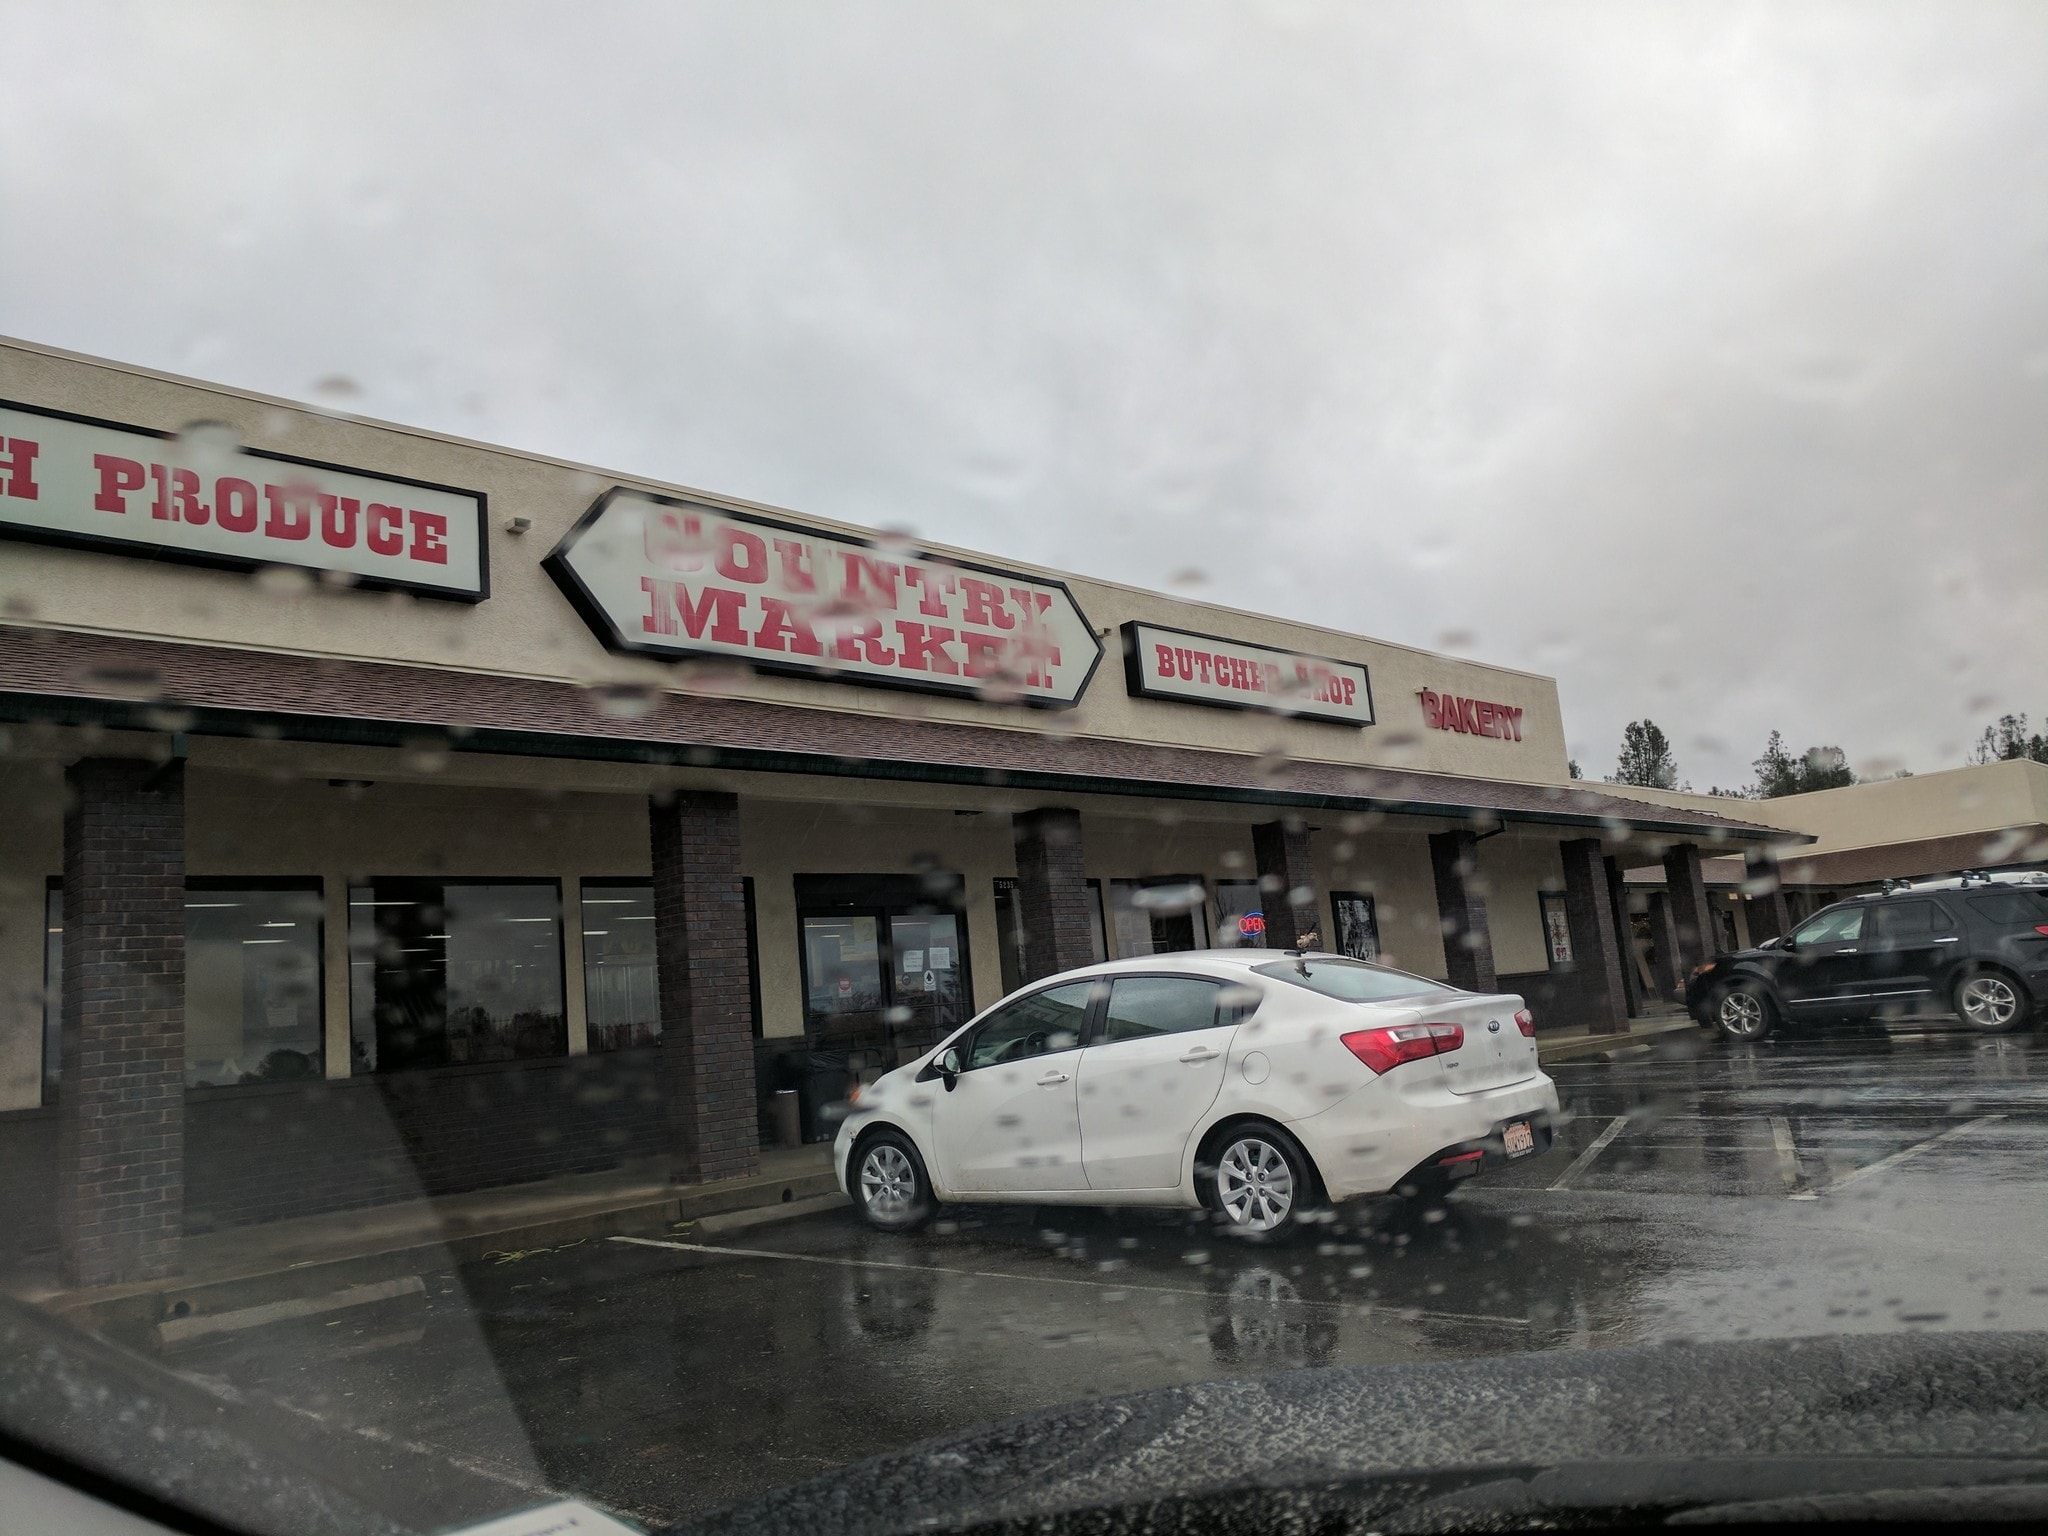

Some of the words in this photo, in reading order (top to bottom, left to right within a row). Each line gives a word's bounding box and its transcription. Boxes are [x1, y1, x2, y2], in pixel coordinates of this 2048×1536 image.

[93, 453, 448, 565] PRODUCE
[644, 513, 1052, 633] COUNTRY
[641, 576, 1061, 689] MARKET
[1420, 691, 1523, 742] BAKERY
[1238, 917, 1266, 932] OPEN
